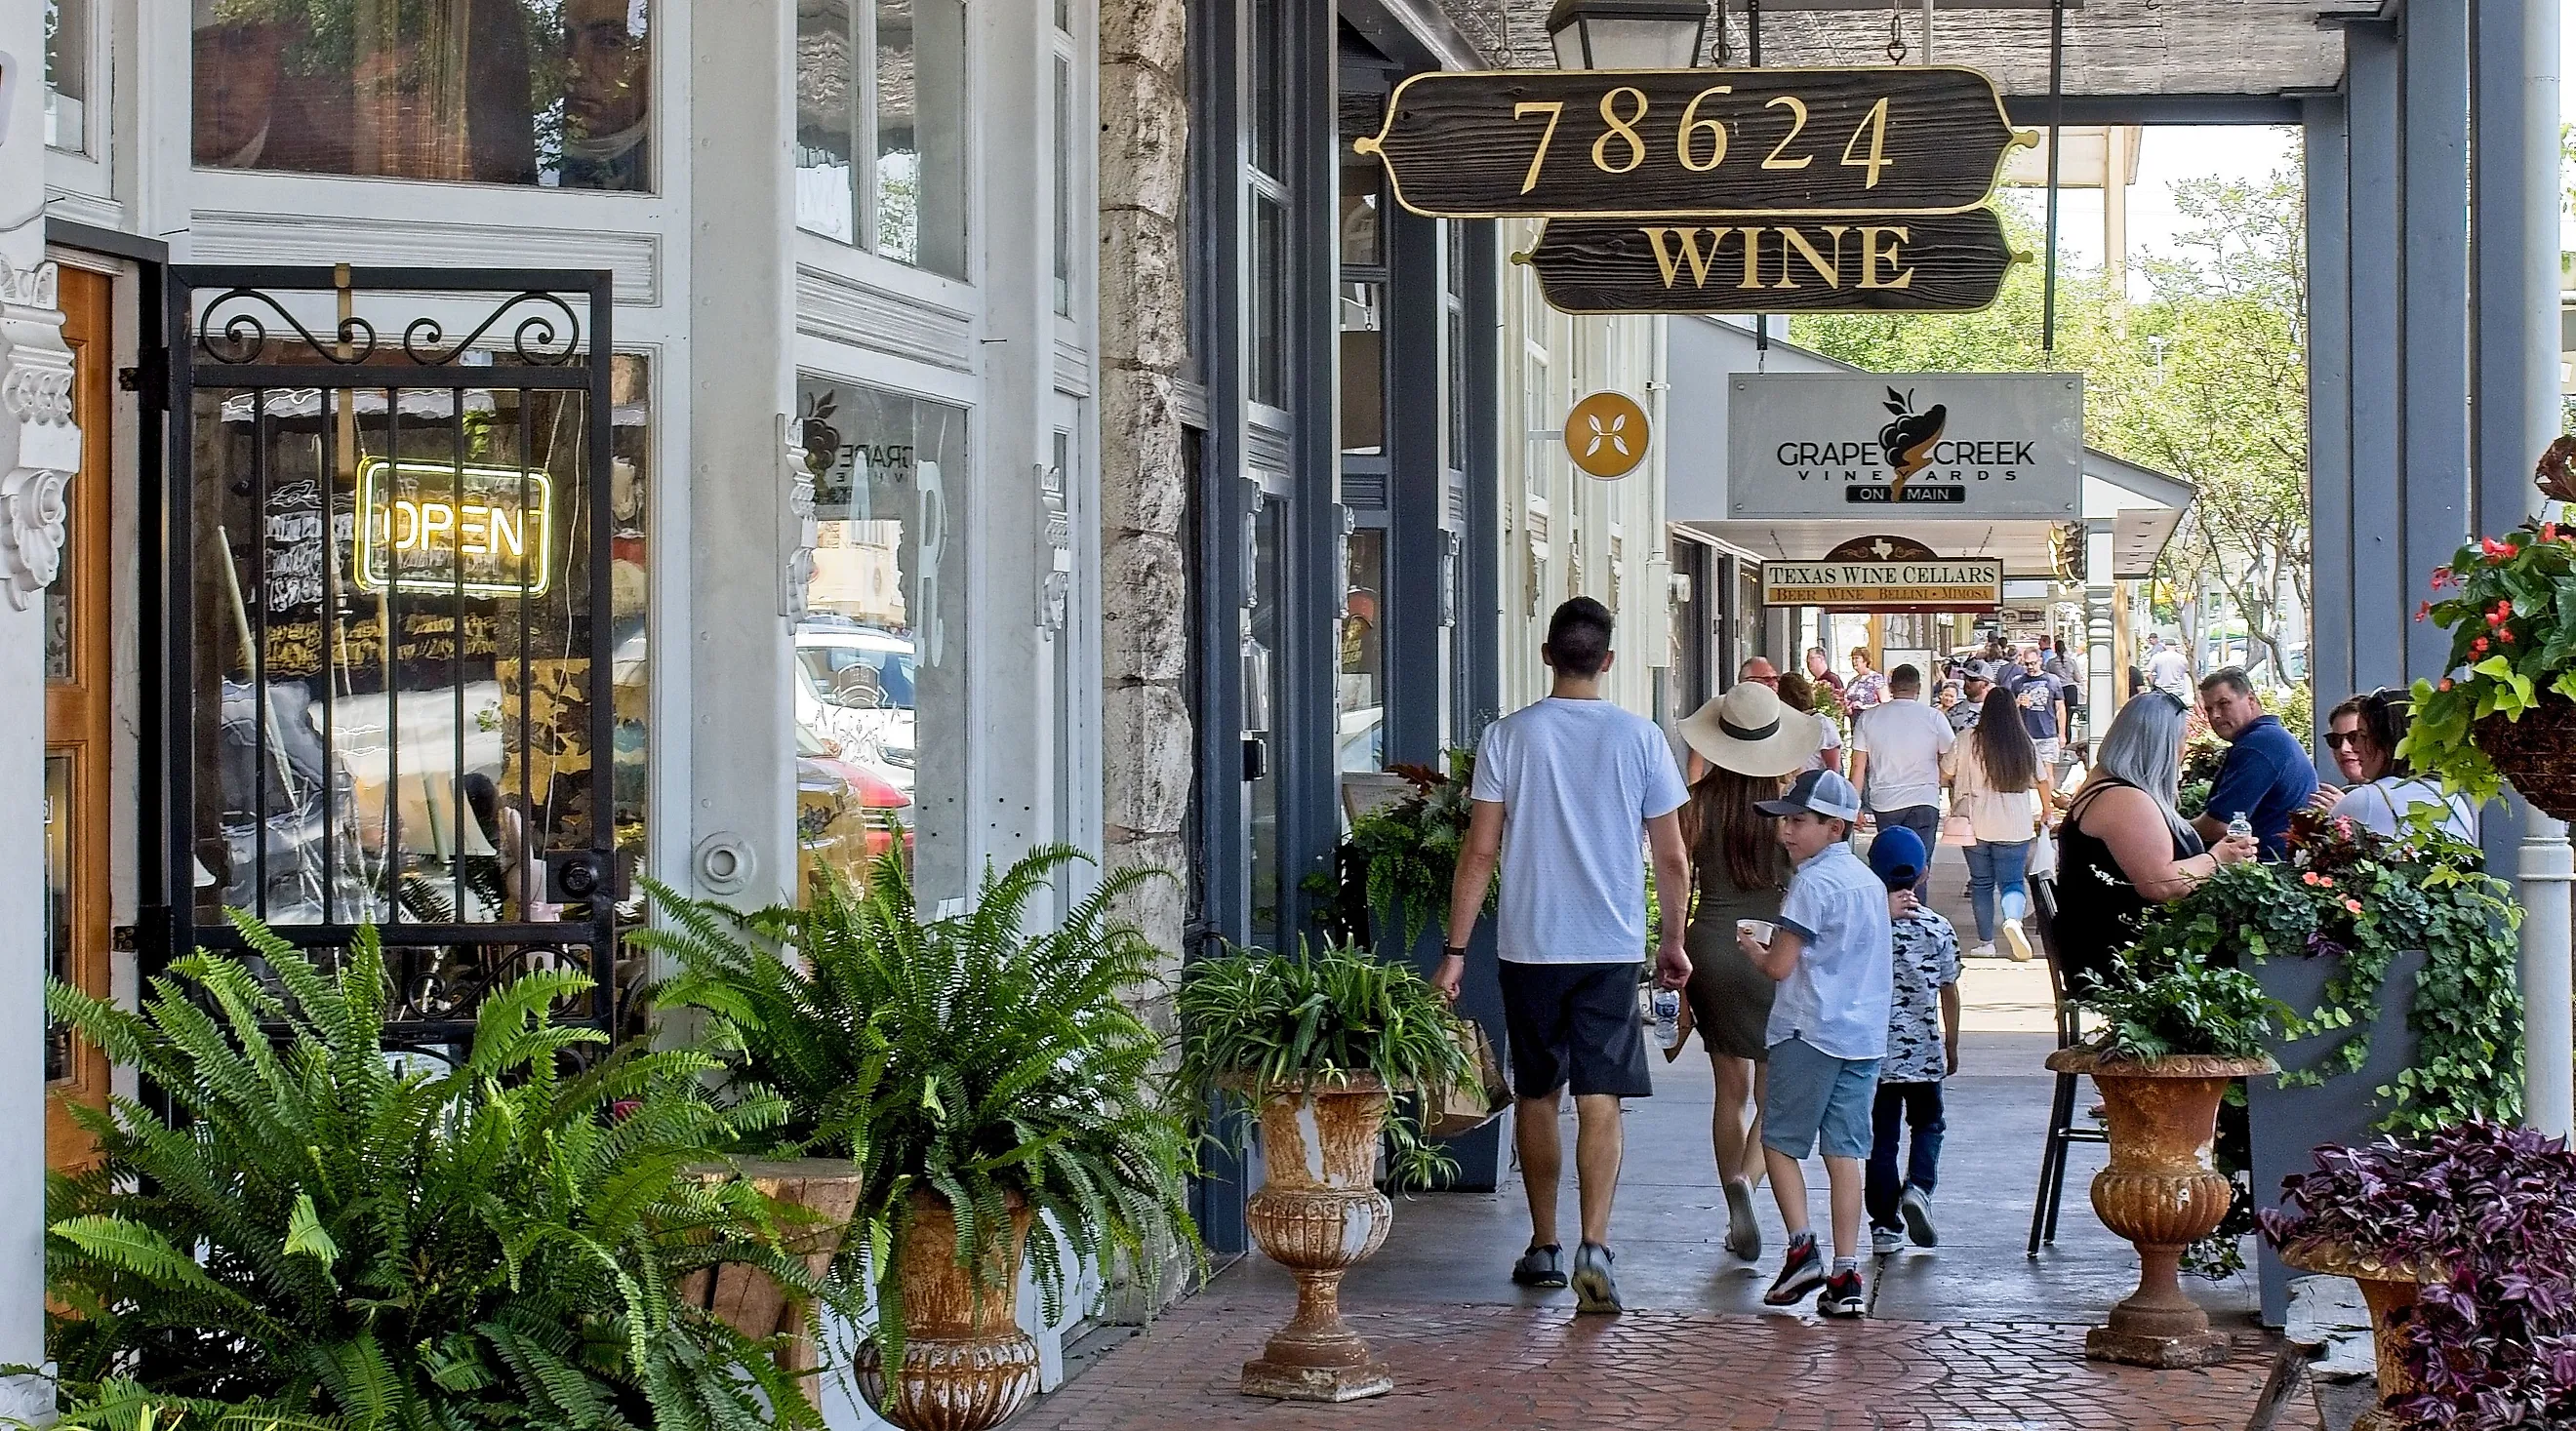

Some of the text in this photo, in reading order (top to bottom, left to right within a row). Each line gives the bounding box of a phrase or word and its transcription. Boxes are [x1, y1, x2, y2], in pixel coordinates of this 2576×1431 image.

[1512, 85, 1893, 195] 78624
[1638, 225, 1914, 290] WINE
[1777, 440, 2035, 466] GRAPE CREEK
[1798, 470, 2017, 481] VINEYARDS
[1860, 488, 1950, 500] ON MAIN
[382, 499, 524, 557] OPEN
[1768, 566, 1995, 584] TEXAS WINE CELLARS
[1777, 587, 1989, 601] BEER WINE BELLINI MIMOSA
